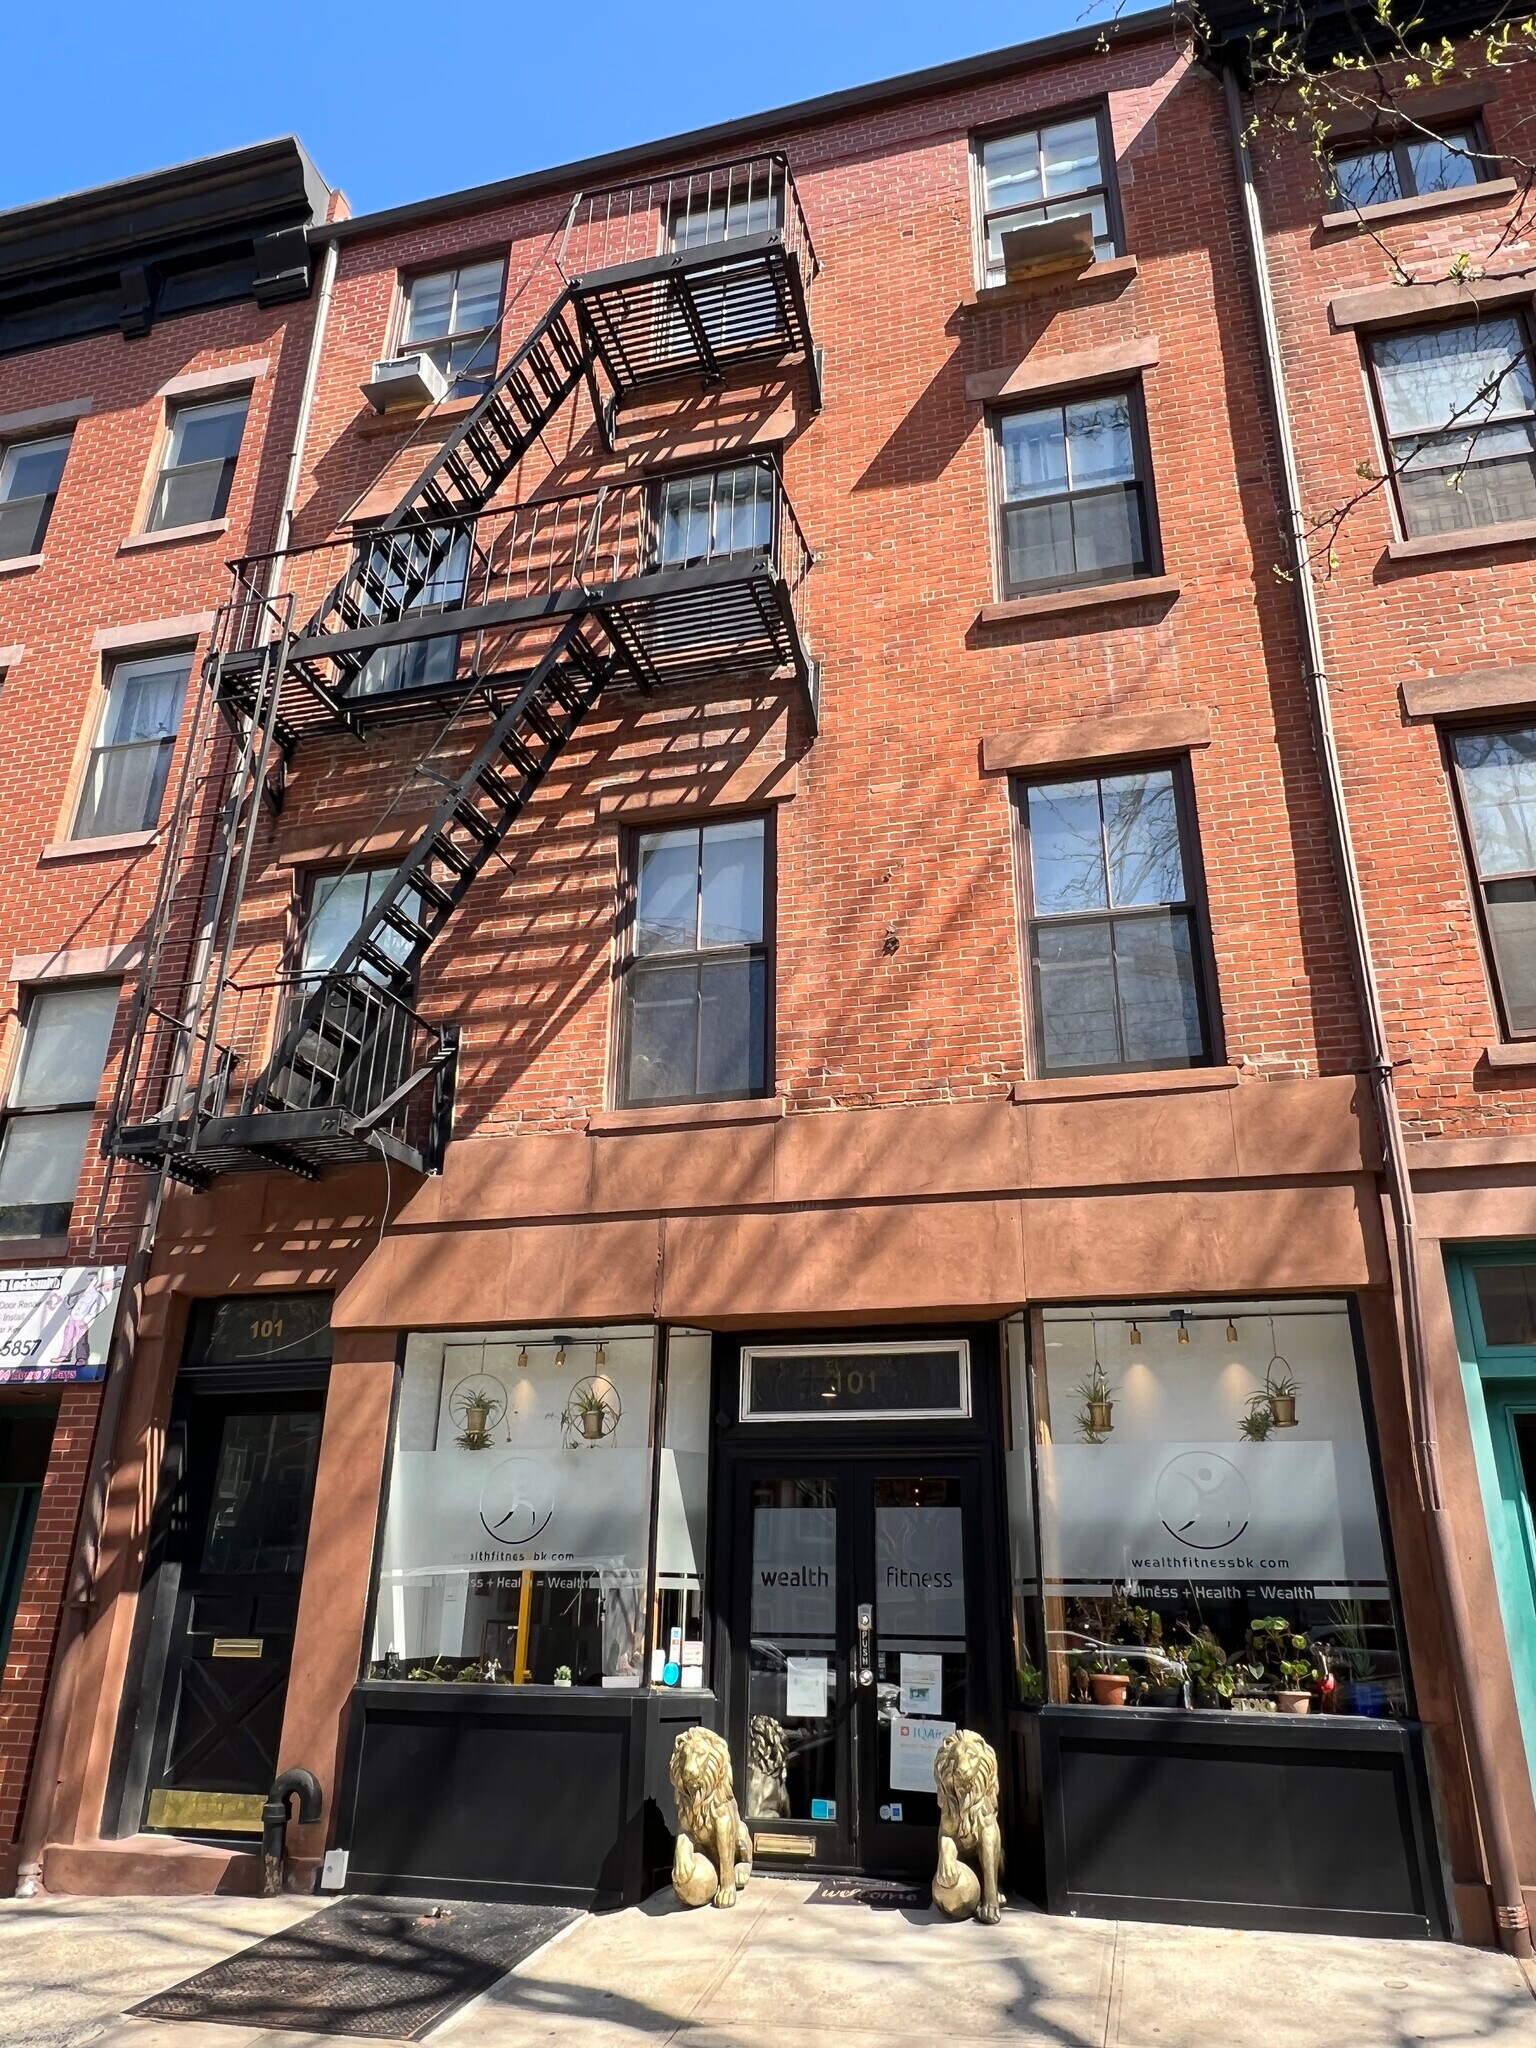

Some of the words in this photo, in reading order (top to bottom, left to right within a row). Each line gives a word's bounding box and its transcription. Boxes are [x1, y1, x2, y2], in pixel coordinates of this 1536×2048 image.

[250, 1320, 283, 1339] 101
[1132, 1556, 1289, 1569] wealthfitnessbk.com
[497, 1577, 533, 1589] Healh
[761, 1566, 829, 1587] wealth
[886, 1566, 953, 1588] fitness
[1196, 1586, 1241, 1599] Health
[1259, 1586, 1313, 1600] Wealth
